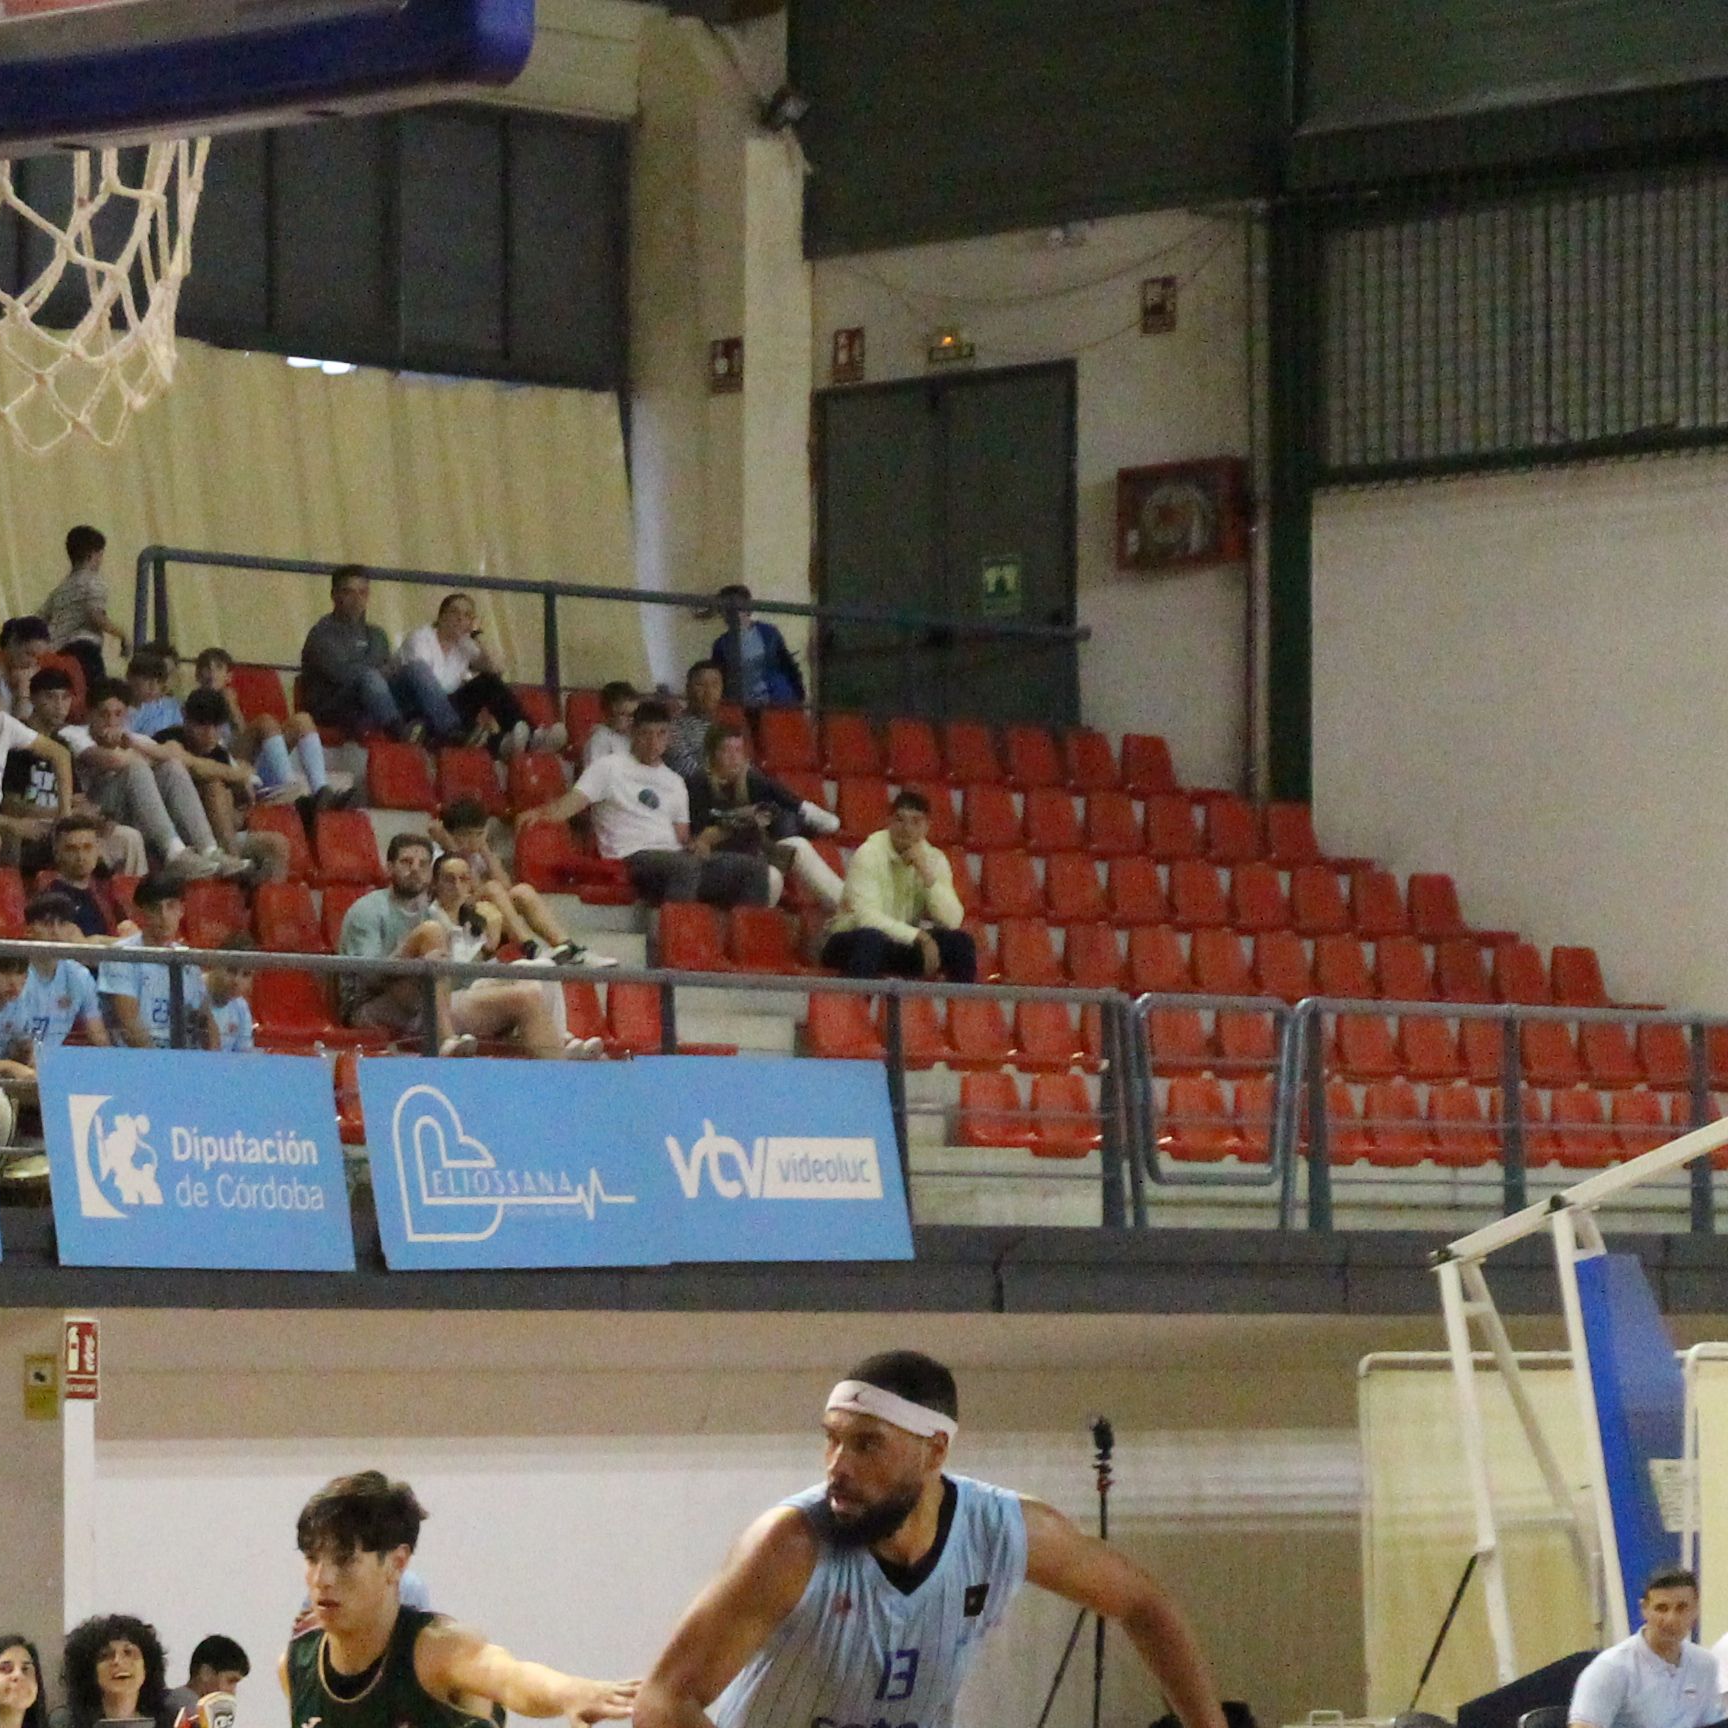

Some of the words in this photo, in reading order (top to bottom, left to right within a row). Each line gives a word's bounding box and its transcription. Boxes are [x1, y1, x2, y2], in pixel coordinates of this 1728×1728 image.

[170, 1126, 319, 1166] Diputación
[777, 1151, 872, 1186] videoluc
[176, 1175, 208, 1206] de
[216, 1174, 325, 1211] Córdoba
[874, 1648, 920, 1701] 13
